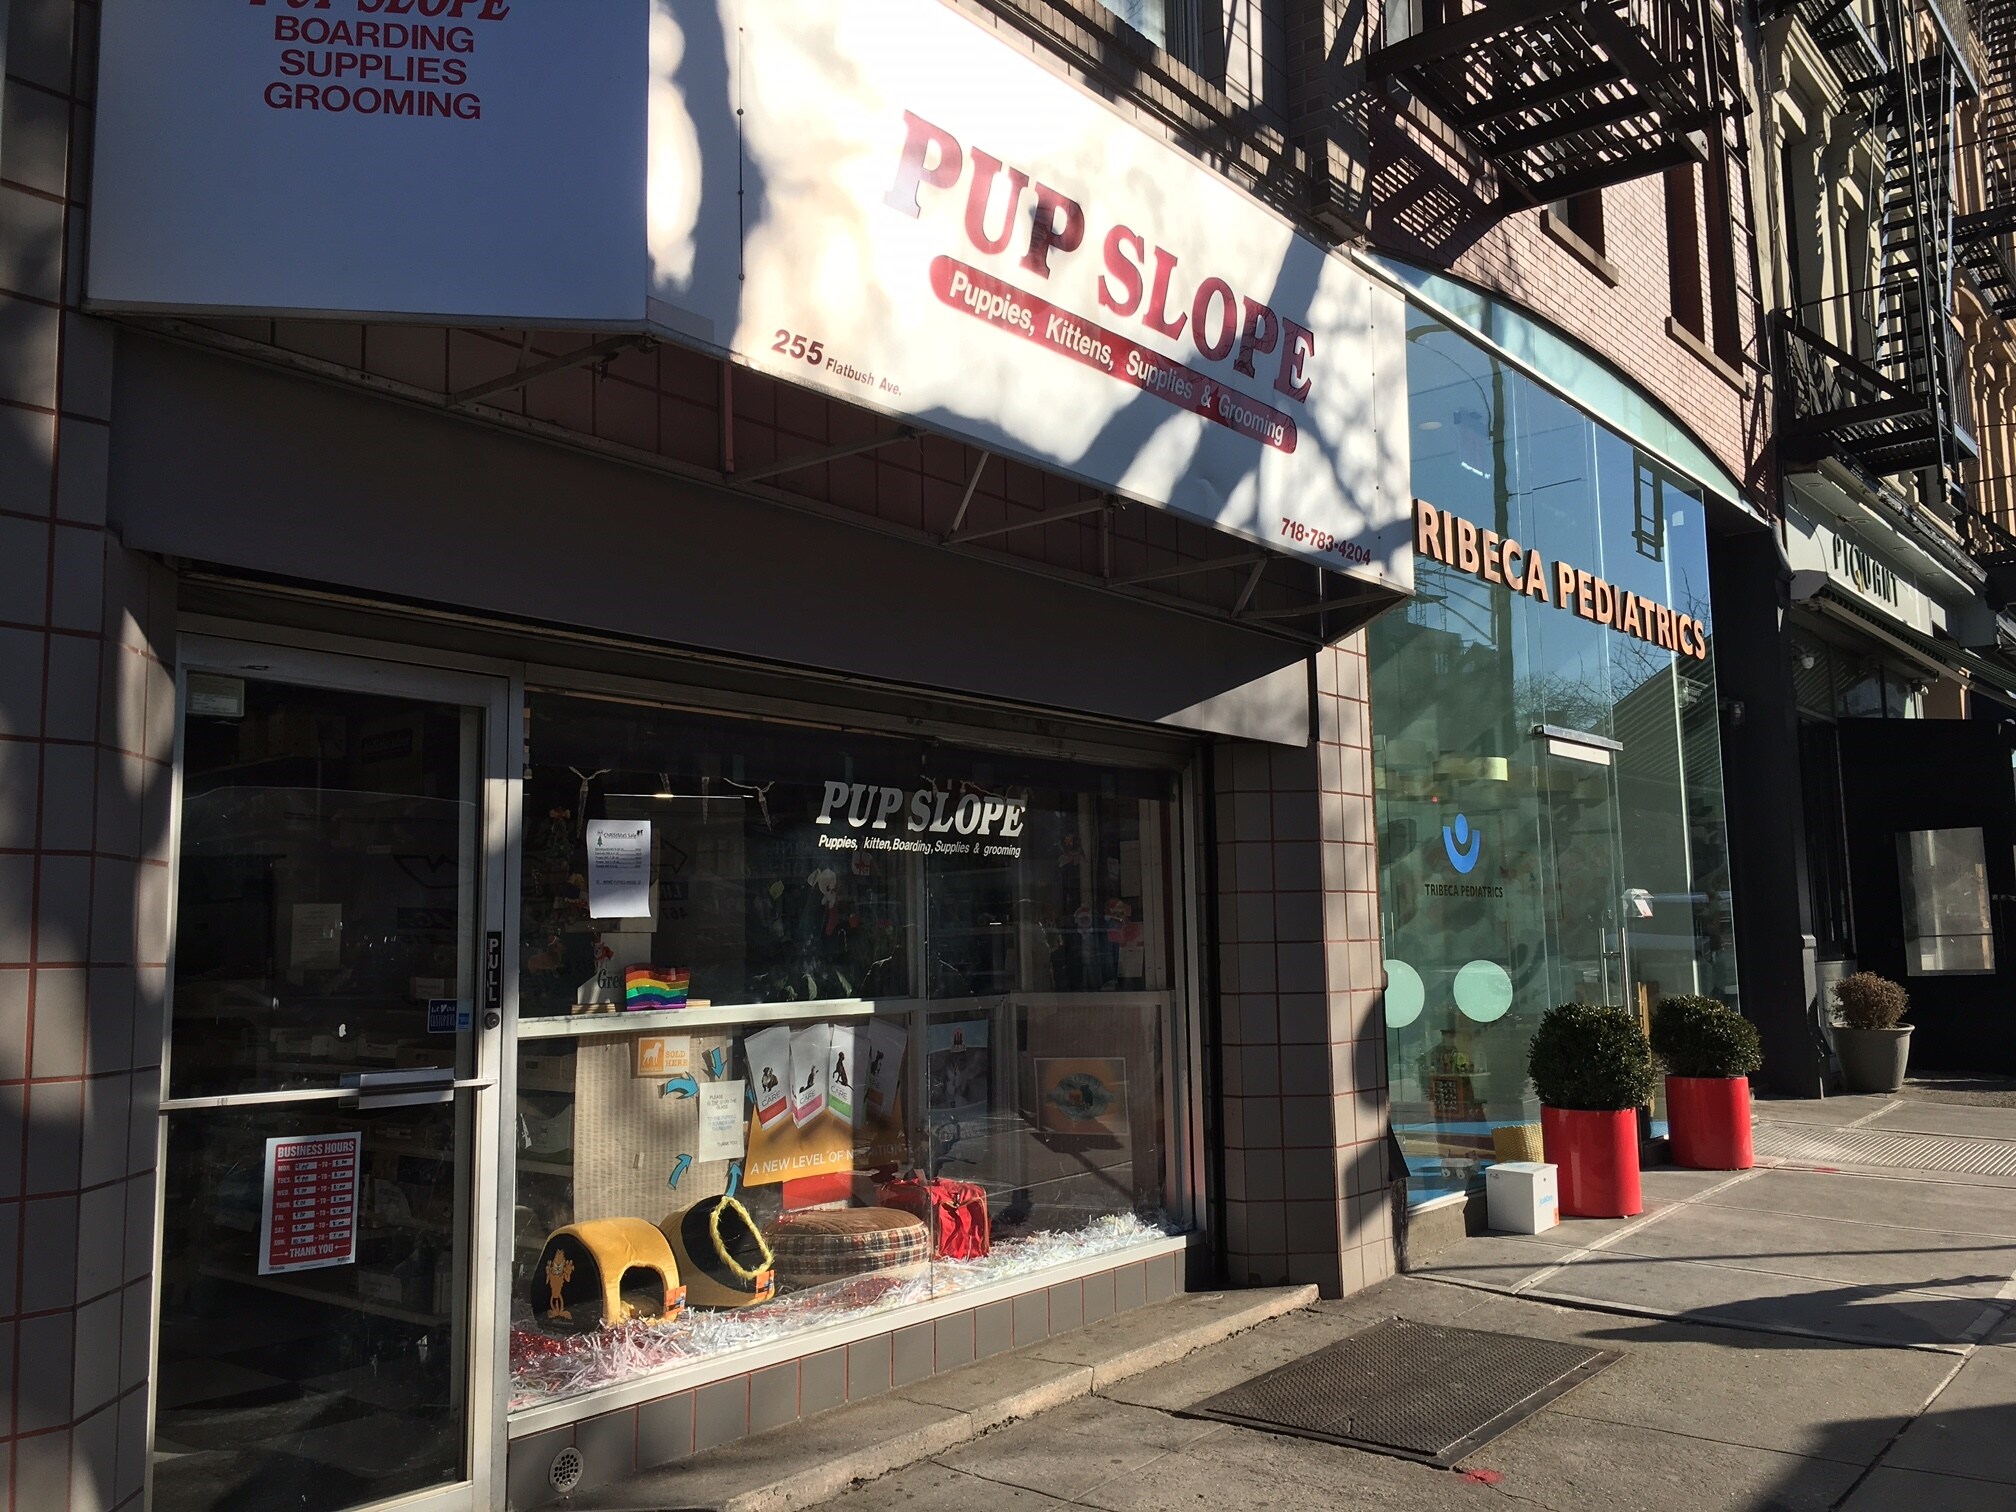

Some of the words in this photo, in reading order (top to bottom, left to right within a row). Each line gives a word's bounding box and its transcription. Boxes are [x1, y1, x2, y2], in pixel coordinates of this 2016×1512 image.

[274, 15, 474, 53] BOARDING
[279, 49, 467, 85] SUPPLIES
[263, 82, 481, 120] GROOMING
[883, 109, 1086, 279] PUP
[1098, 224, 1315, 403] SLOPE
[771, 329, 824, 365] 255
[825, 358, 875, 386] Flatbush
[879, 377, 902, 397] Ave.
[949, 270, 1036, 337] Puppies,
[1045, 312, 1115, 371] Kittens,
[1126, 350, 1193, 400] Supplies
[1200, 384, 1211, 408] &
[1218, 393, 1286, 445] Grooming
[1281, 517, 1371, 565] 718-783-4204
[1415, 498, 1549, 603] RIBECA
[1554, 560, 1707, 661] PEDIATRICS
[1833, 533, 1898, 607] PIQUANT
[815, 780, 904, 829] PUP
[907, 788, 1026, 838] SLOPE
[818, 834, 858, 850] Puppies,
[973, 843, 980, 853] &
[983, 844, 1021, 858] grooming
[1425, 884, 1459, 897] TRIBECA
[1461, 885, 1503, 898] PEDIATRICS
[489, 938, 500, 1002] PULL
[665, 1050, 685, 1058] SOLD
[665, 1059, 688, 1067] HERE
[762, 1090, 781, 1106] CARE
[799, 1091, 816, 1104] CARE
[830, 1085, 848, 1100] CARE
[277, 1143, 323, 1158] BUSINESS
[324, 1141, 354, 1153] HOURS
[751, 1162, 760, 1175] A
[762, 1157, 790, 1172] NEW
[793, 1153, 826, 1168] LEVEL
[828, 1151, 844, 1163] OF
[290, 1245, 316, 1258] THANK
[318, 1243, 333, 1255] YOU
